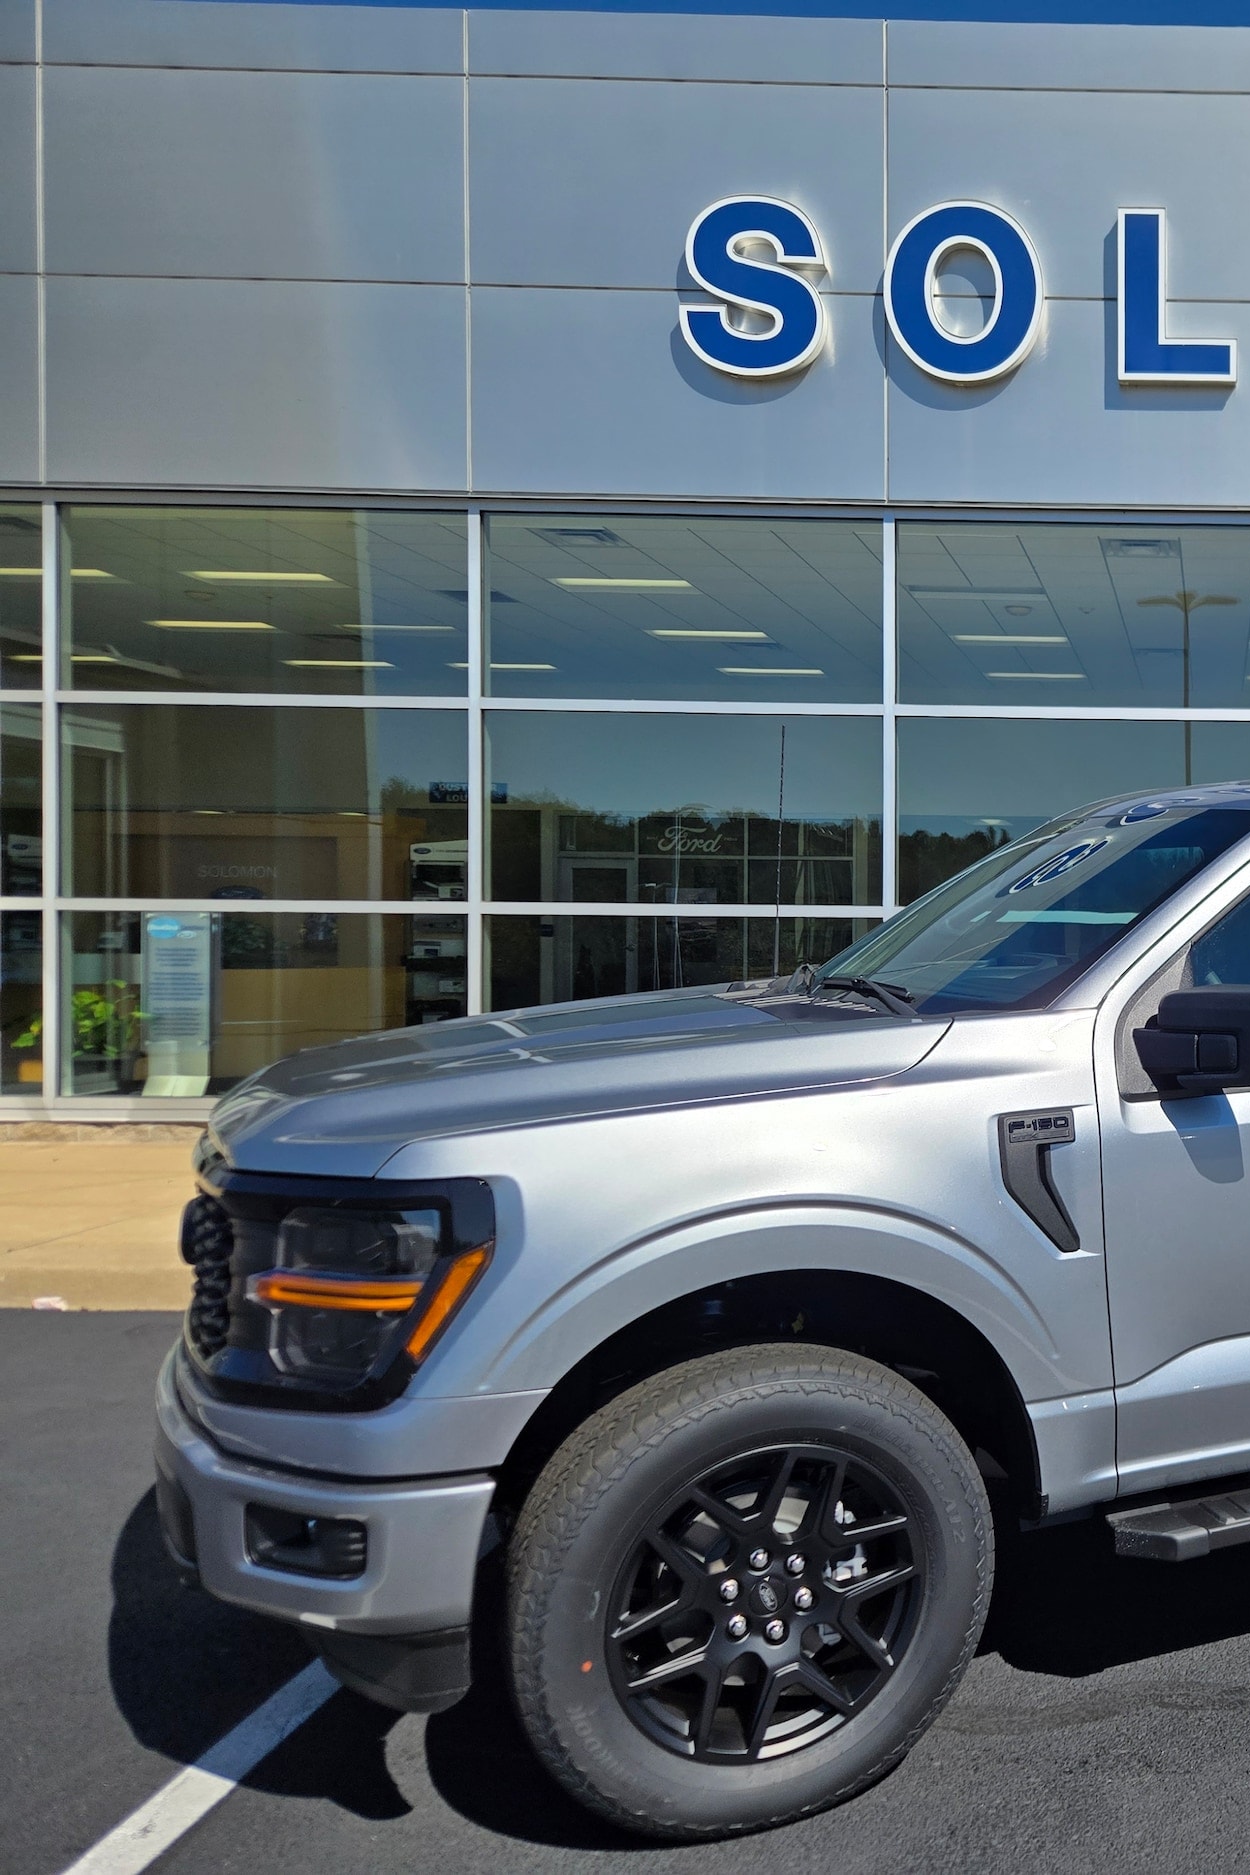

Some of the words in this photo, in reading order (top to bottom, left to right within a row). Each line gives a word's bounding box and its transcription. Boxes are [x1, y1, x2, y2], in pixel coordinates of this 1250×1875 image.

[657, 825, 722, 853] Ford
[199, 865, 278, 878] SOLOMON
[1008, 1116, 1069, 1134] F-150
